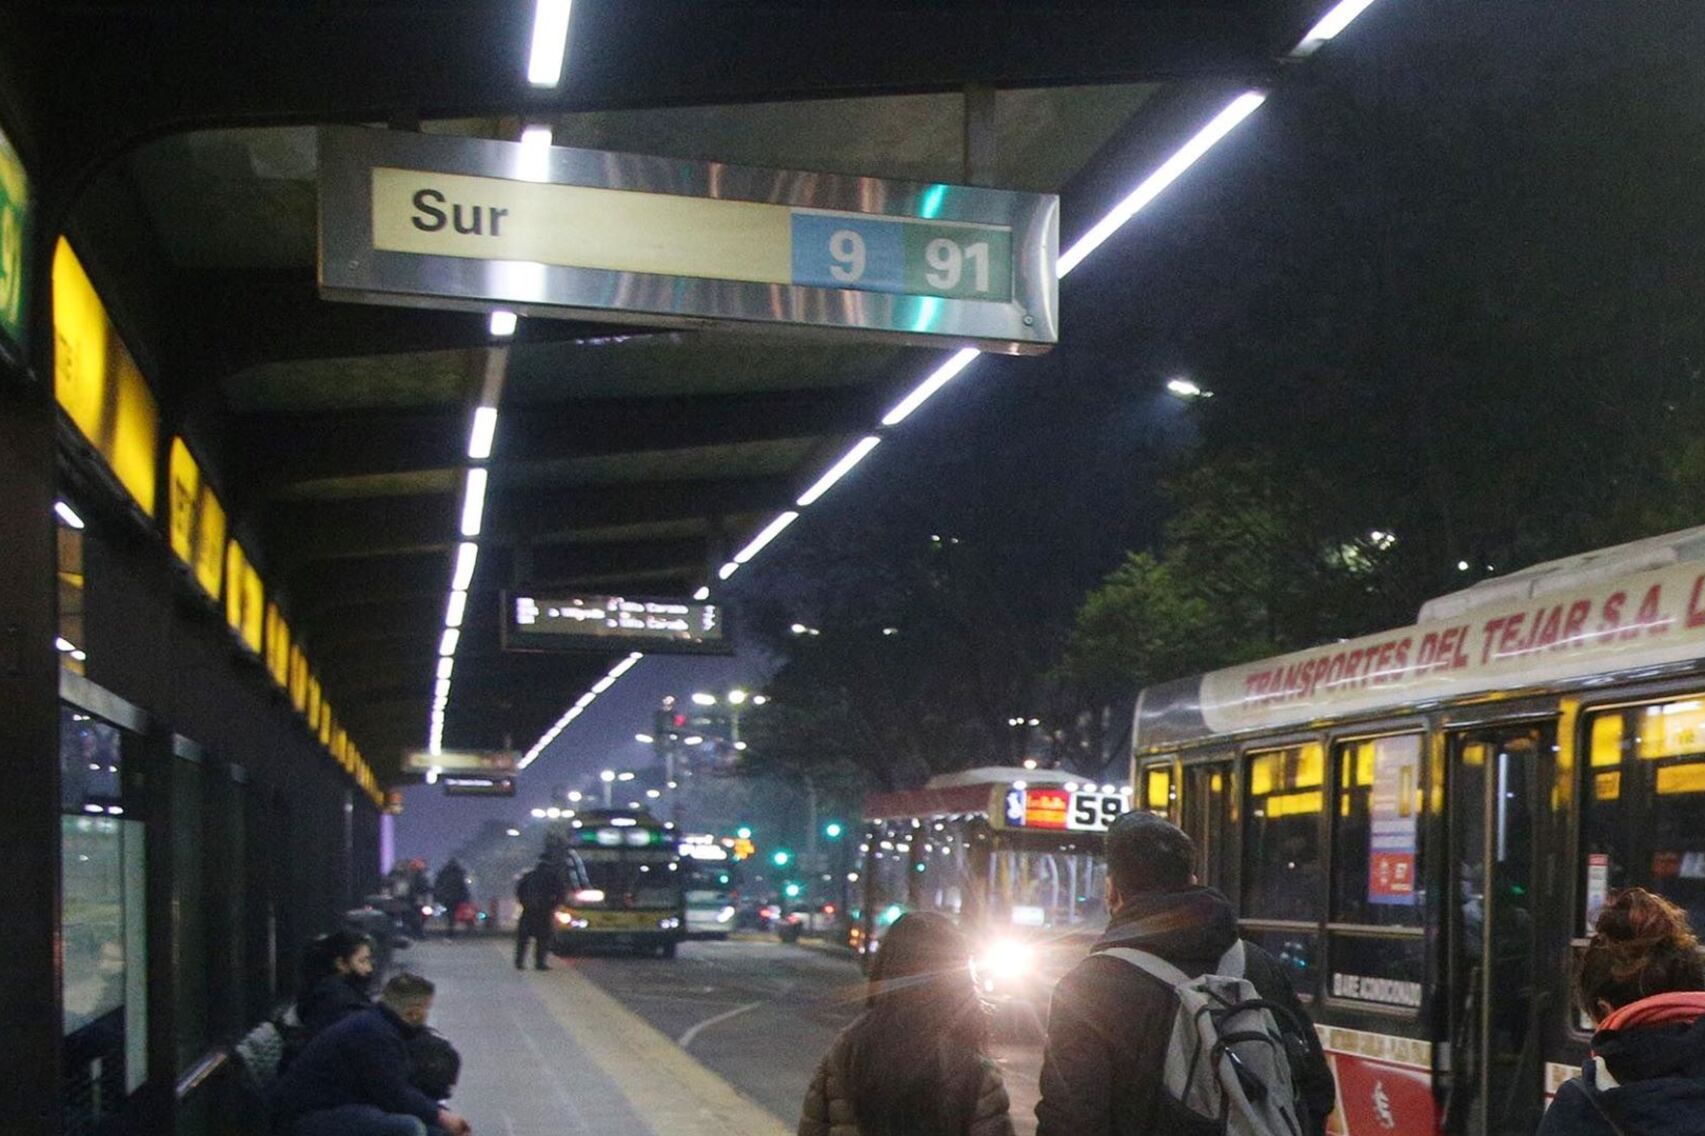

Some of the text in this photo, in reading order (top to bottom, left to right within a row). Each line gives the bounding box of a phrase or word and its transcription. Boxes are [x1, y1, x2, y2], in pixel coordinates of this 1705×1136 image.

[410, 188, 990, 291] Sur 9 91
[1243, 636, 1412, 710] TRANSPORTES
[1414, 625, 1469, 676] DEL
[1482, 599, 1592, 664] TEJAR
[1074, 795, 1122, 826] 59
